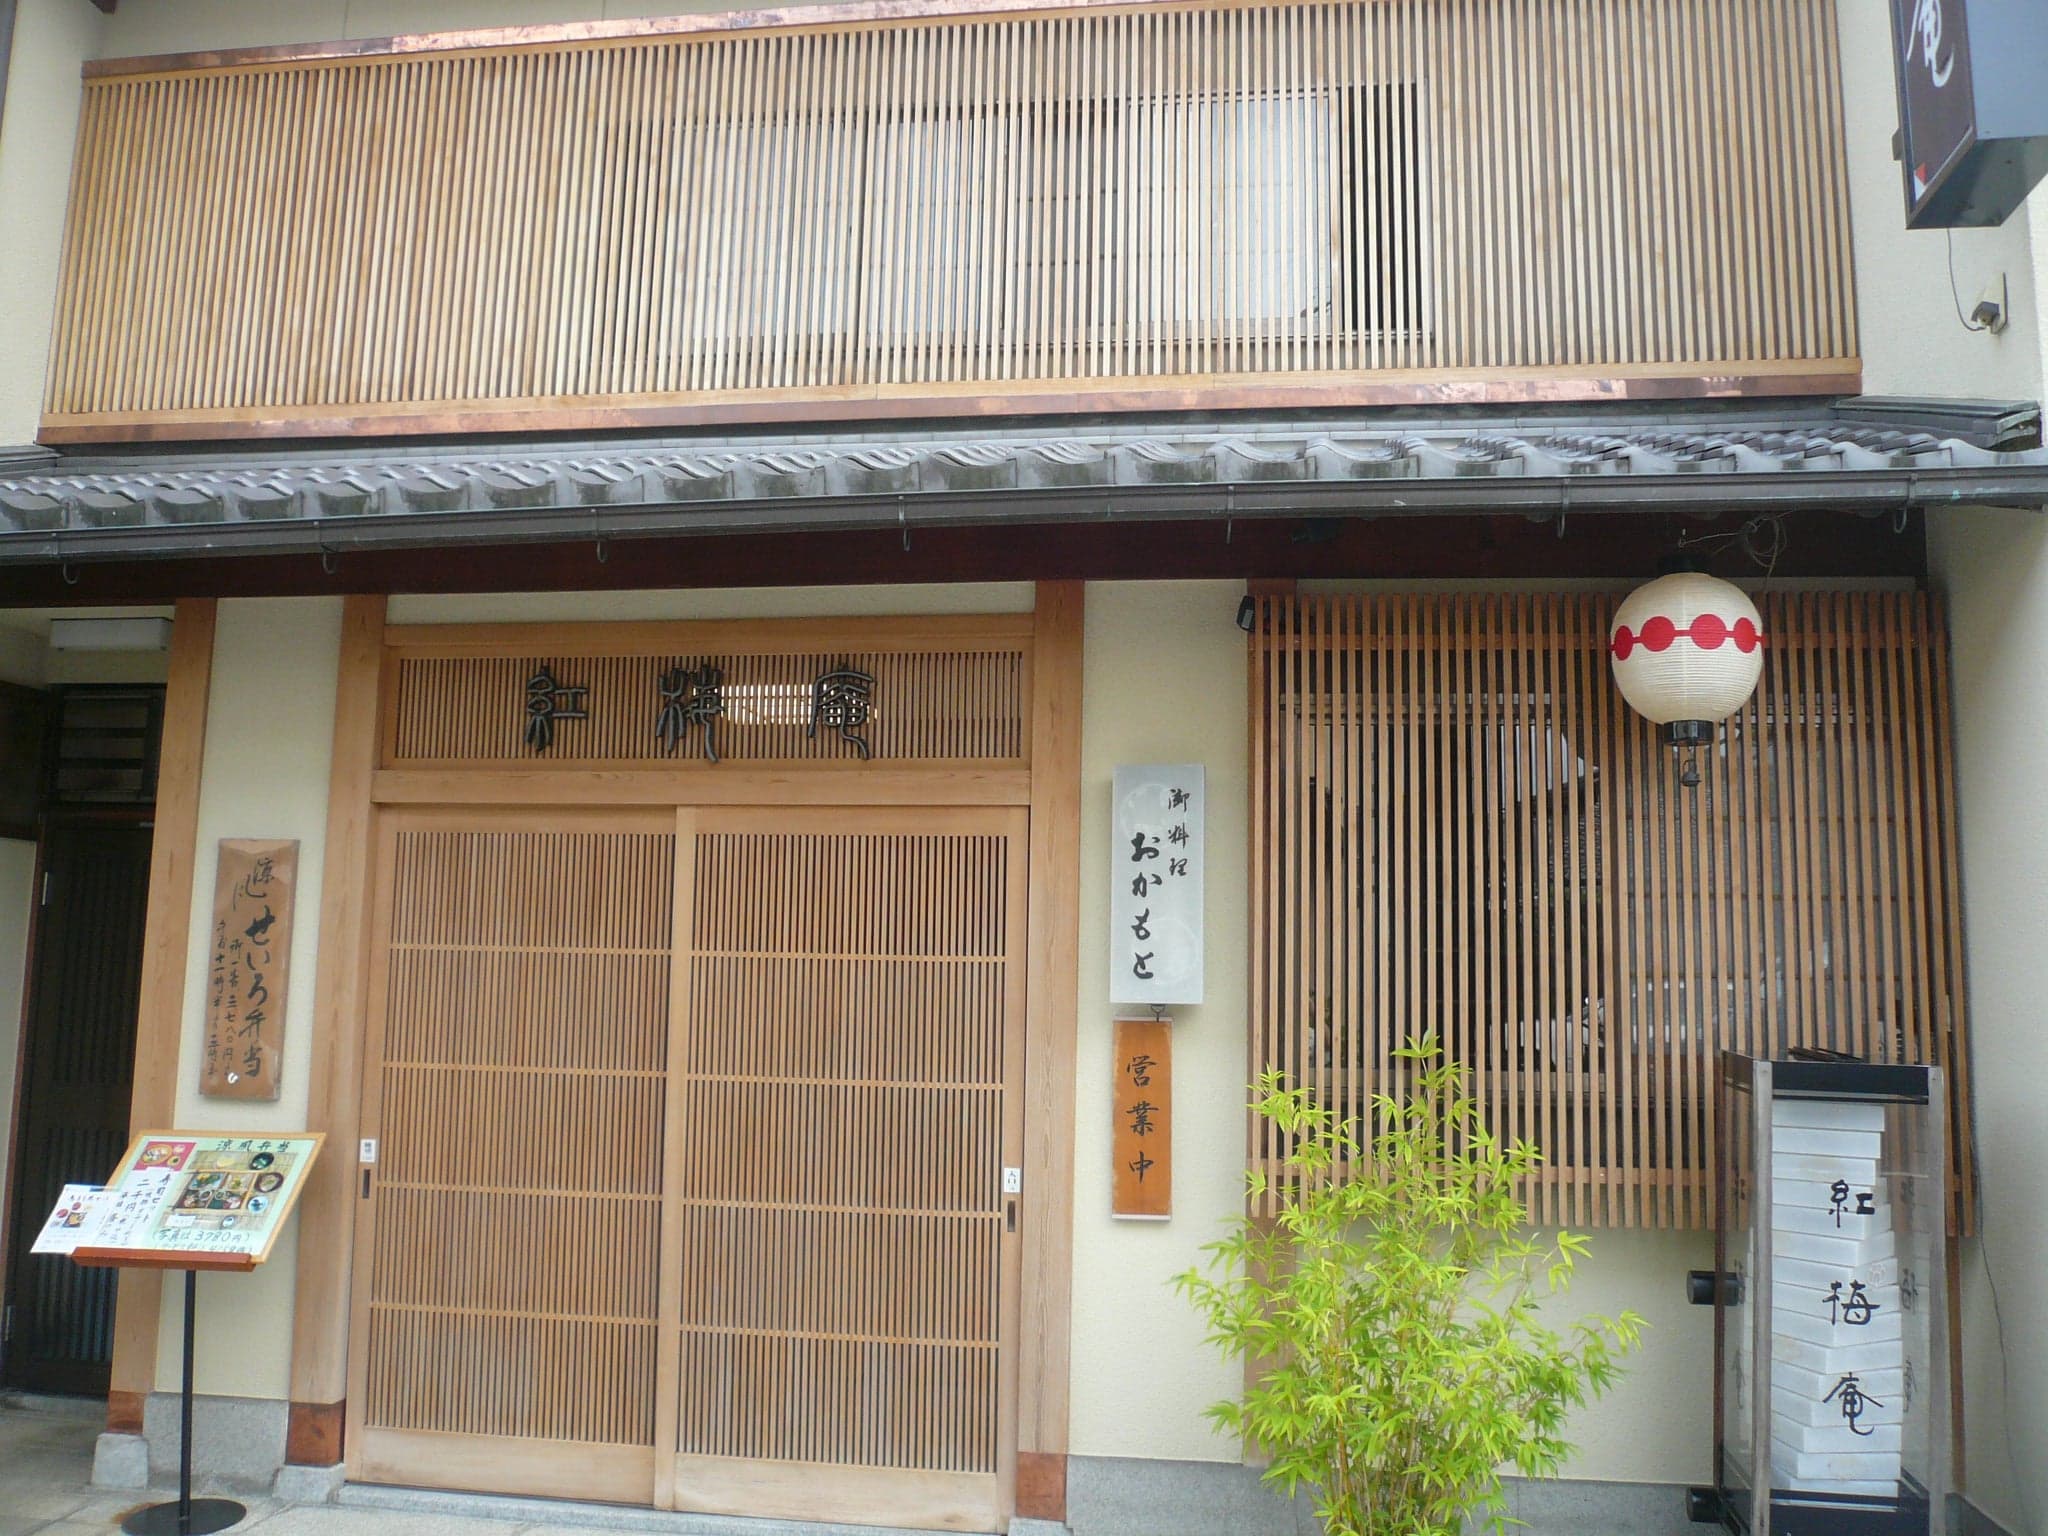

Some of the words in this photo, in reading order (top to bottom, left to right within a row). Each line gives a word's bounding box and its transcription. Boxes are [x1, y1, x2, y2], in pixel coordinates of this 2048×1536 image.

[1167, 788, 1190, 877] 御料理
[1131, 831, 1163, 980] おかもと
[1126, 1055, 1159, 1184] 営業中
[1822, 1178, 1884, 1436] 紅梅庵
